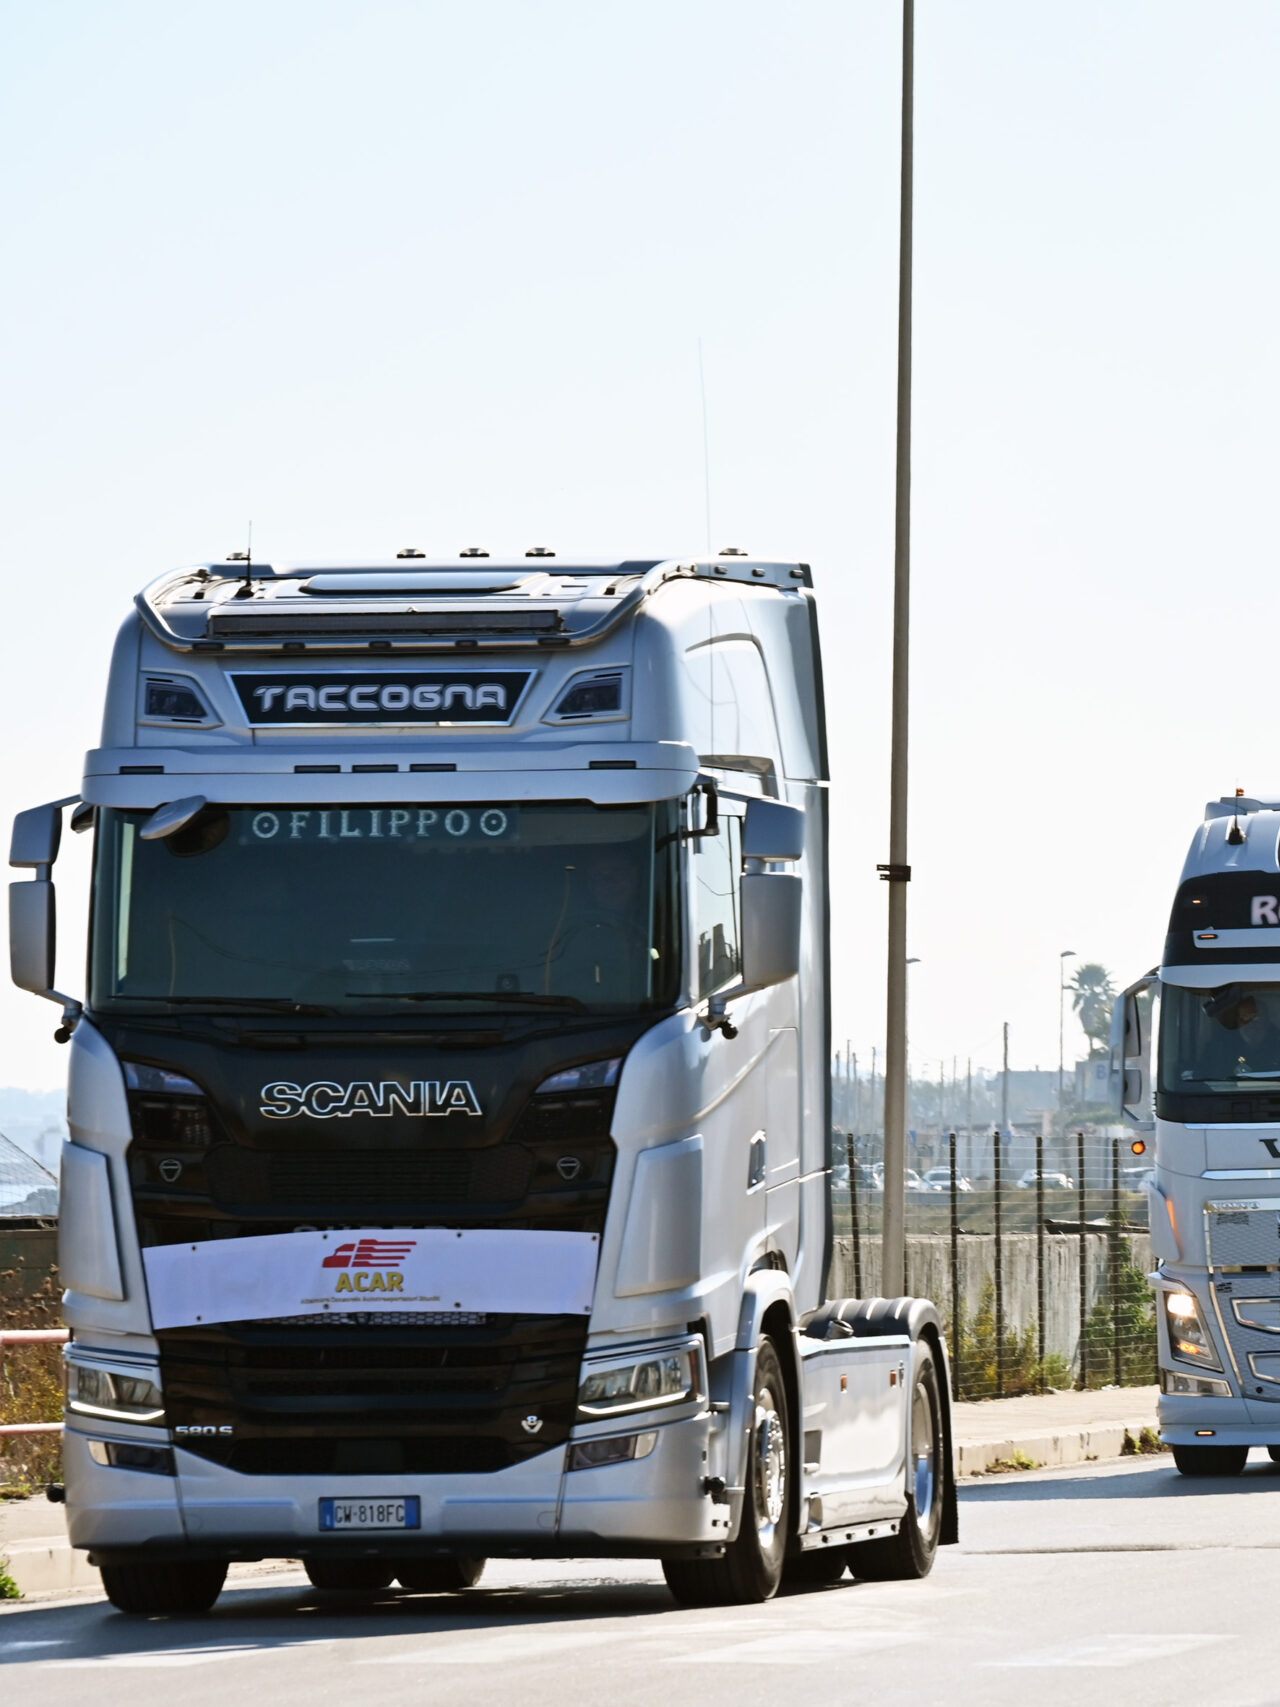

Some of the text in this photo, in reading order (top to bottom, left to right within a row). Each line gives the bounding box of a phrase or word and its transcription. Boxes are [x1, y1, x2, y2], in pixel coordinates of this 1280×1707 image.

[254, 684, 507, 712] TACCOGNA
[259, 1081, 483, 1119] SCANIA
[335, 1271, 405, 1293] ACAR
